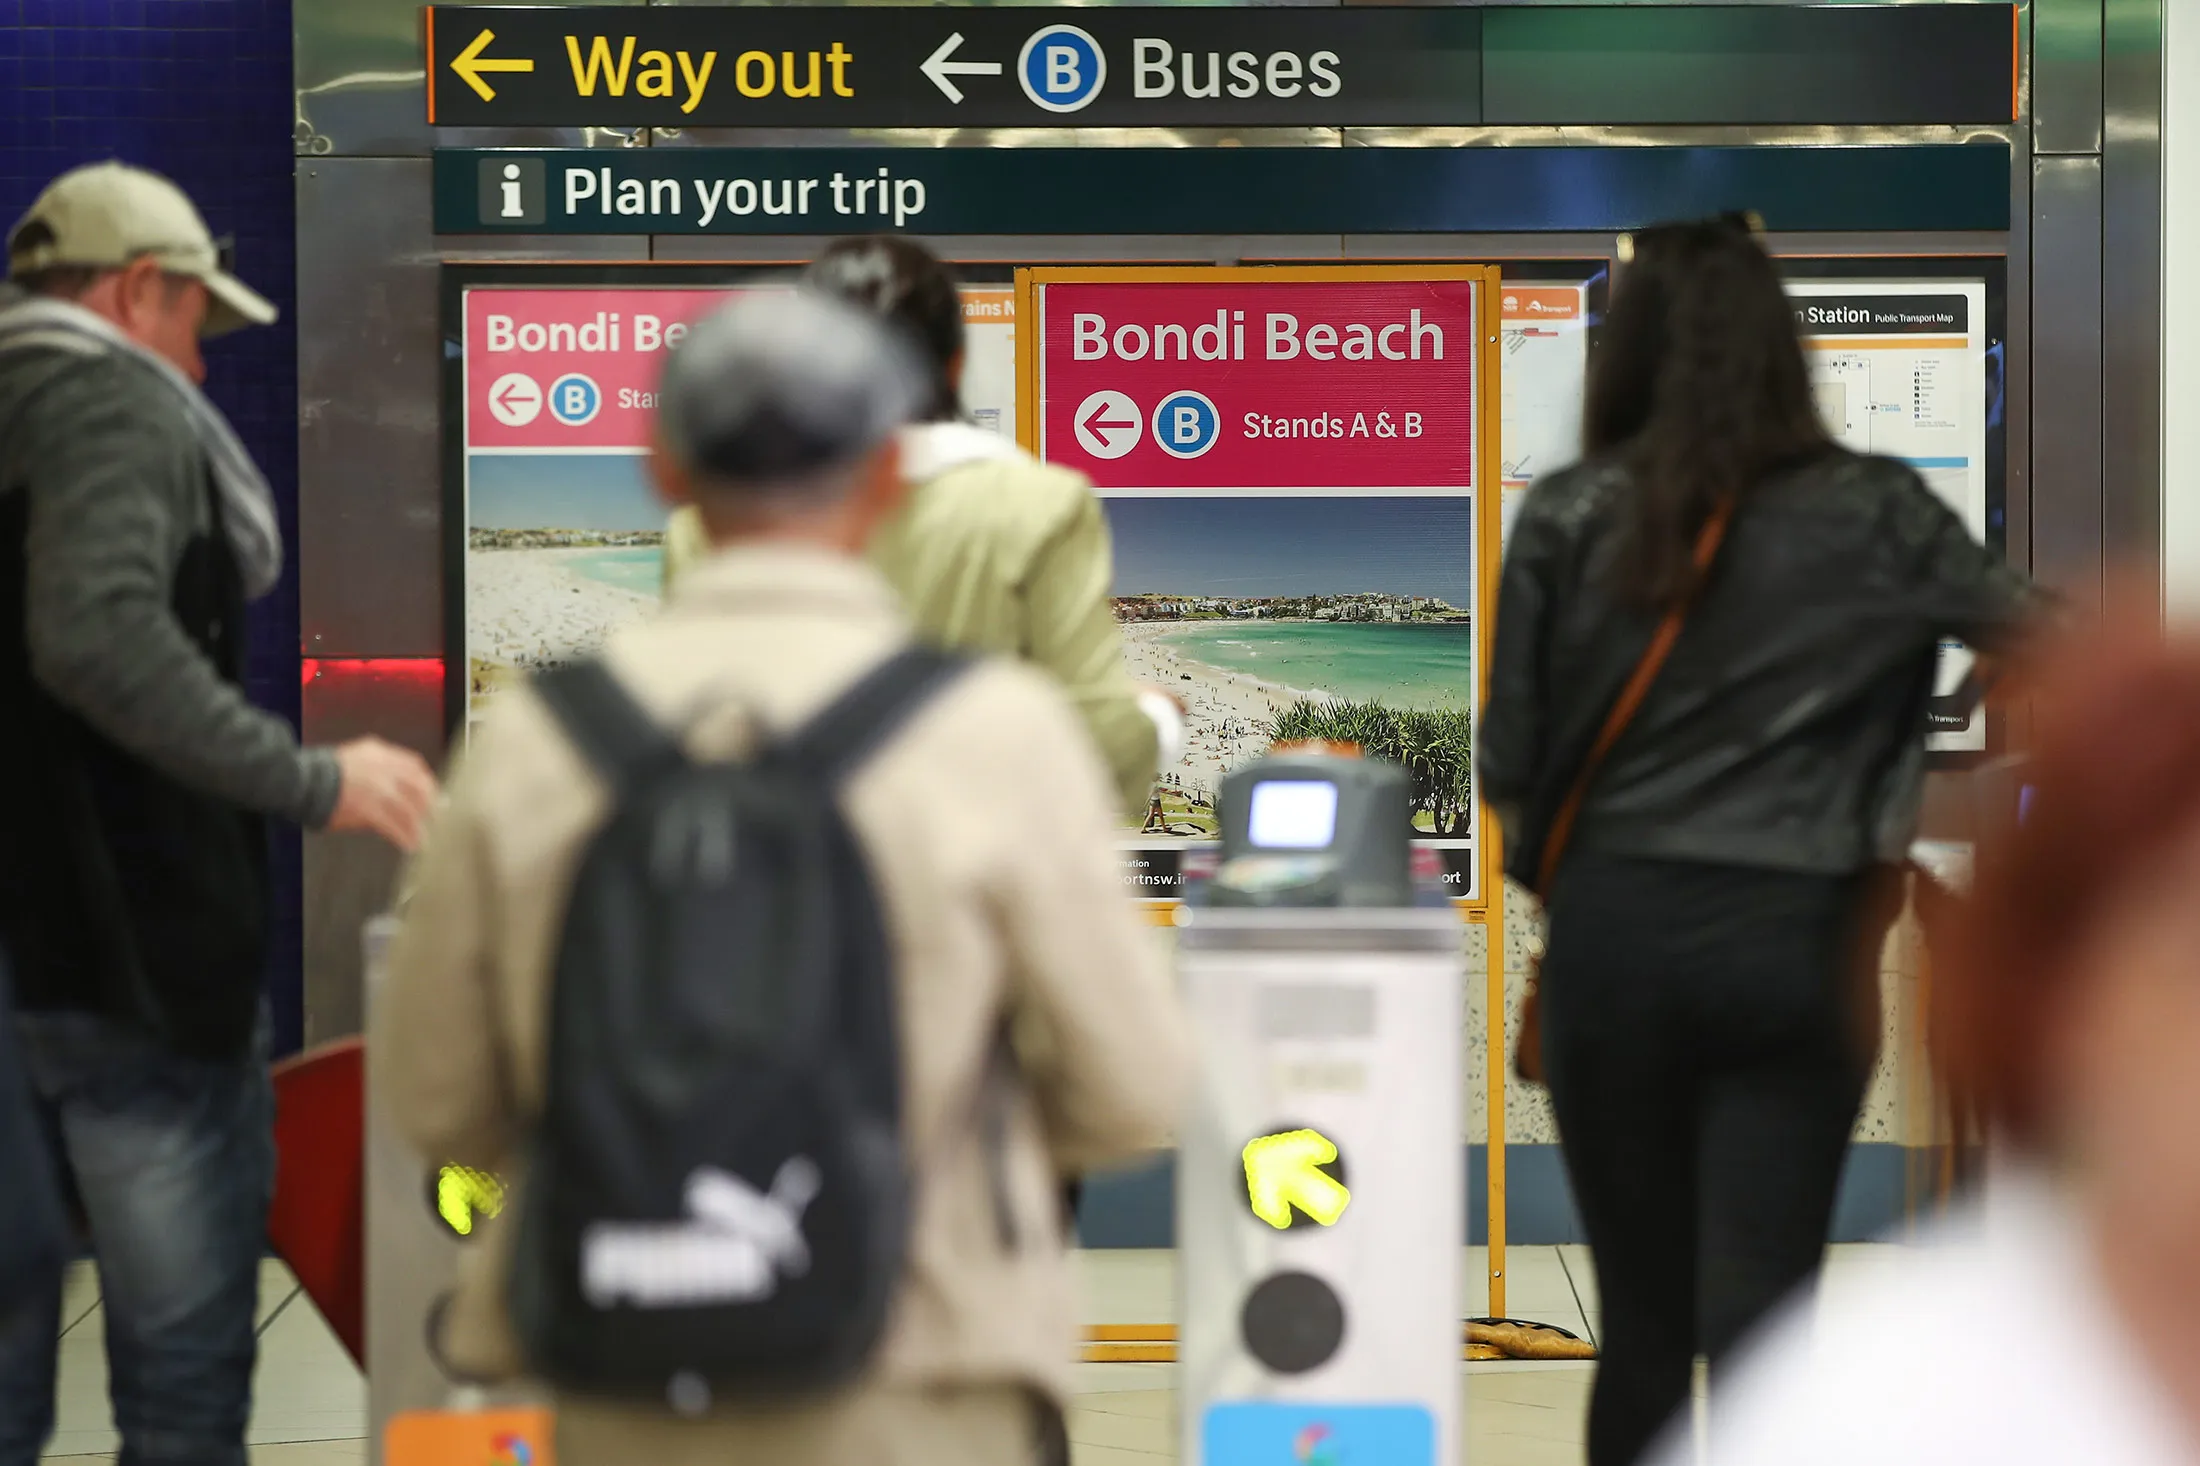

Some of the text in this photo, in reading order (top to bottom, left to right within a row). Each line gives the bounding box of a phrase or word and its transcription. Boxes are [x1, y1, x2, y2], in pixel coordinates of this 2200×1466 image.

[565, 35, 855, 114] Way out
[1045, 37, 1342, 100] B Buses
[564, 167, 682, 216] Plan
[695, 171, 818, 228] your
[829, 167, 927, 227] trip
[960, 300, 1002, 317] rains
[1807, 305, 1870, 324] Station
[1875, 313, 1898, 323] Public
[1899, 313, 1936, 325] Transport
[1937, 313, 1954, 324] Map
[486, 311, 689, 353] Bondi Be
[1073, 309, 1245, 362] Bondi
[1265, 308, 1445, 362] Beach
[563, 385, 661, 415] B Sta
[1172, 407, 1423, 442] B Stands A & B
[1119, 860, 1149, 868] mation
[1441, 871, 1461, 884] ort
